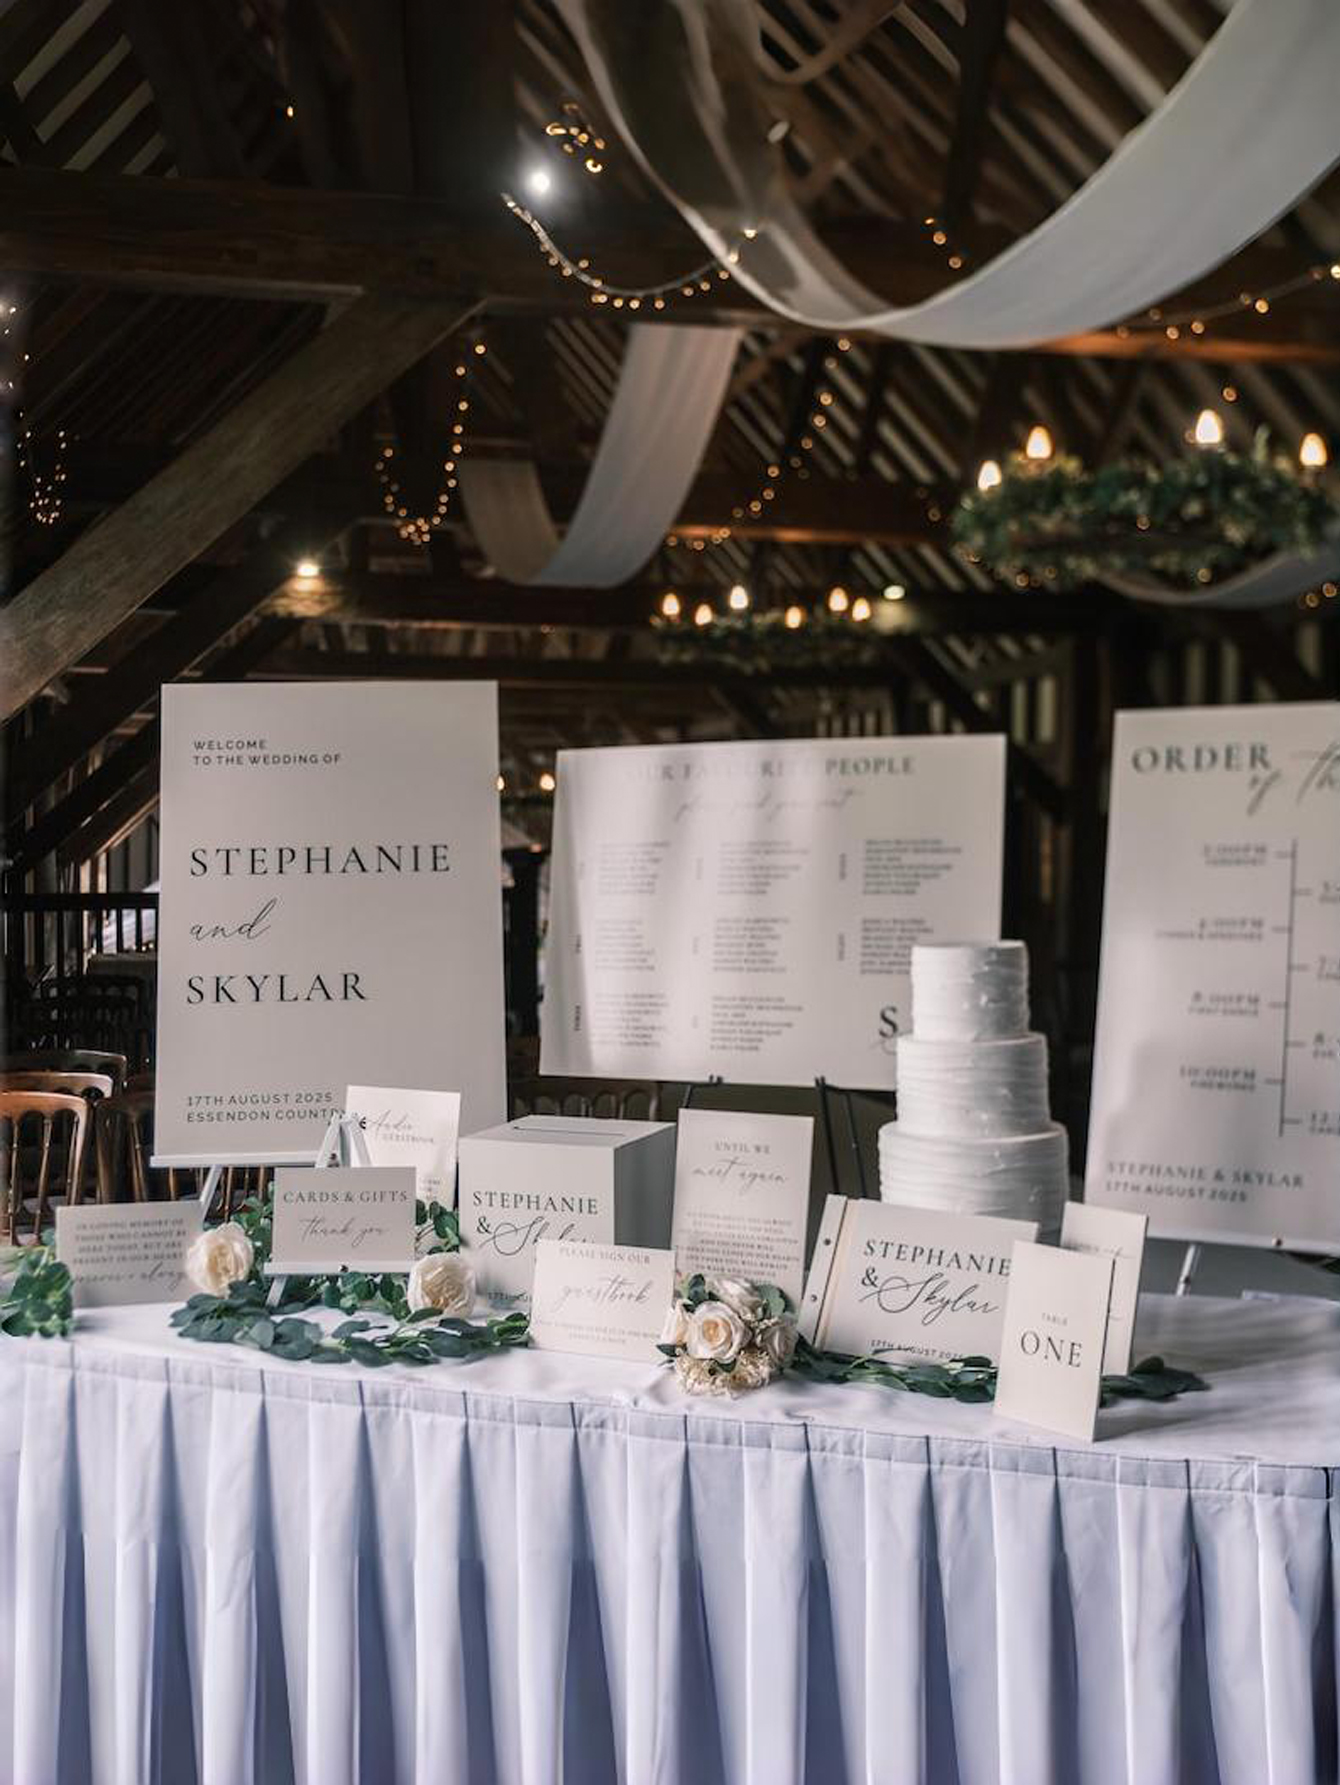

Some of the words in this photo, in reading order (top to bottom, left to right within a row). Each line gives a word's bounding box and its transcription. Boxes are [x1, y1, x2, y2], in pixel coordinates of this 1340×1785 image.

[193, 739, 268, 751] WELCOME
[193, 755, 212, 765] TO
[217, 755, 244, 765] THE
[249, 754, 318, 765] WEDDING
[323, 753, 342, 764] OF
[824, 756, 916, 777] PEOPLE
[1131, 742, 1272, 774] ORDER
[189, 844, 451, 877] STEPHANIE
[189, 898, 278, 942] and
[186, 973, 368, 1005] SKYLAR
[187, 1096, 224, 1107] 17TH
[228, 1095, 290, 1106] AUGUST
[187, 1111, 271, 1124] ESSENDON
[715, 1141, 751, 1153] UNTIL
[754, 1144, 771, 1155] WE
[1107, 1160, 1205, 1181] STEPHANIE
[1214, 1168, 1225, 1182] &
[1232, 1170, 1304, 1189] SKYLAR
[283, 1191, 340, 1203] CARDS
[344, 1191, 355, 1203] &
[360, 1190, 409, 1203] GIFTS
[1145, 1183, 1206, 1199] AUGUST
[473, 1191, 598, 1215] STEPHANIE
[476, 1215, 492, 1235] &
[863, 1239, 1011, 1277] STEPHANIE
[861, 1266, 879, 1288] &
[858, 1273, 1001, 1326] Skylar
[1041, 1312, 1069, 1326] TABLE
[1020, 1330, 1083, 1368] ONE
